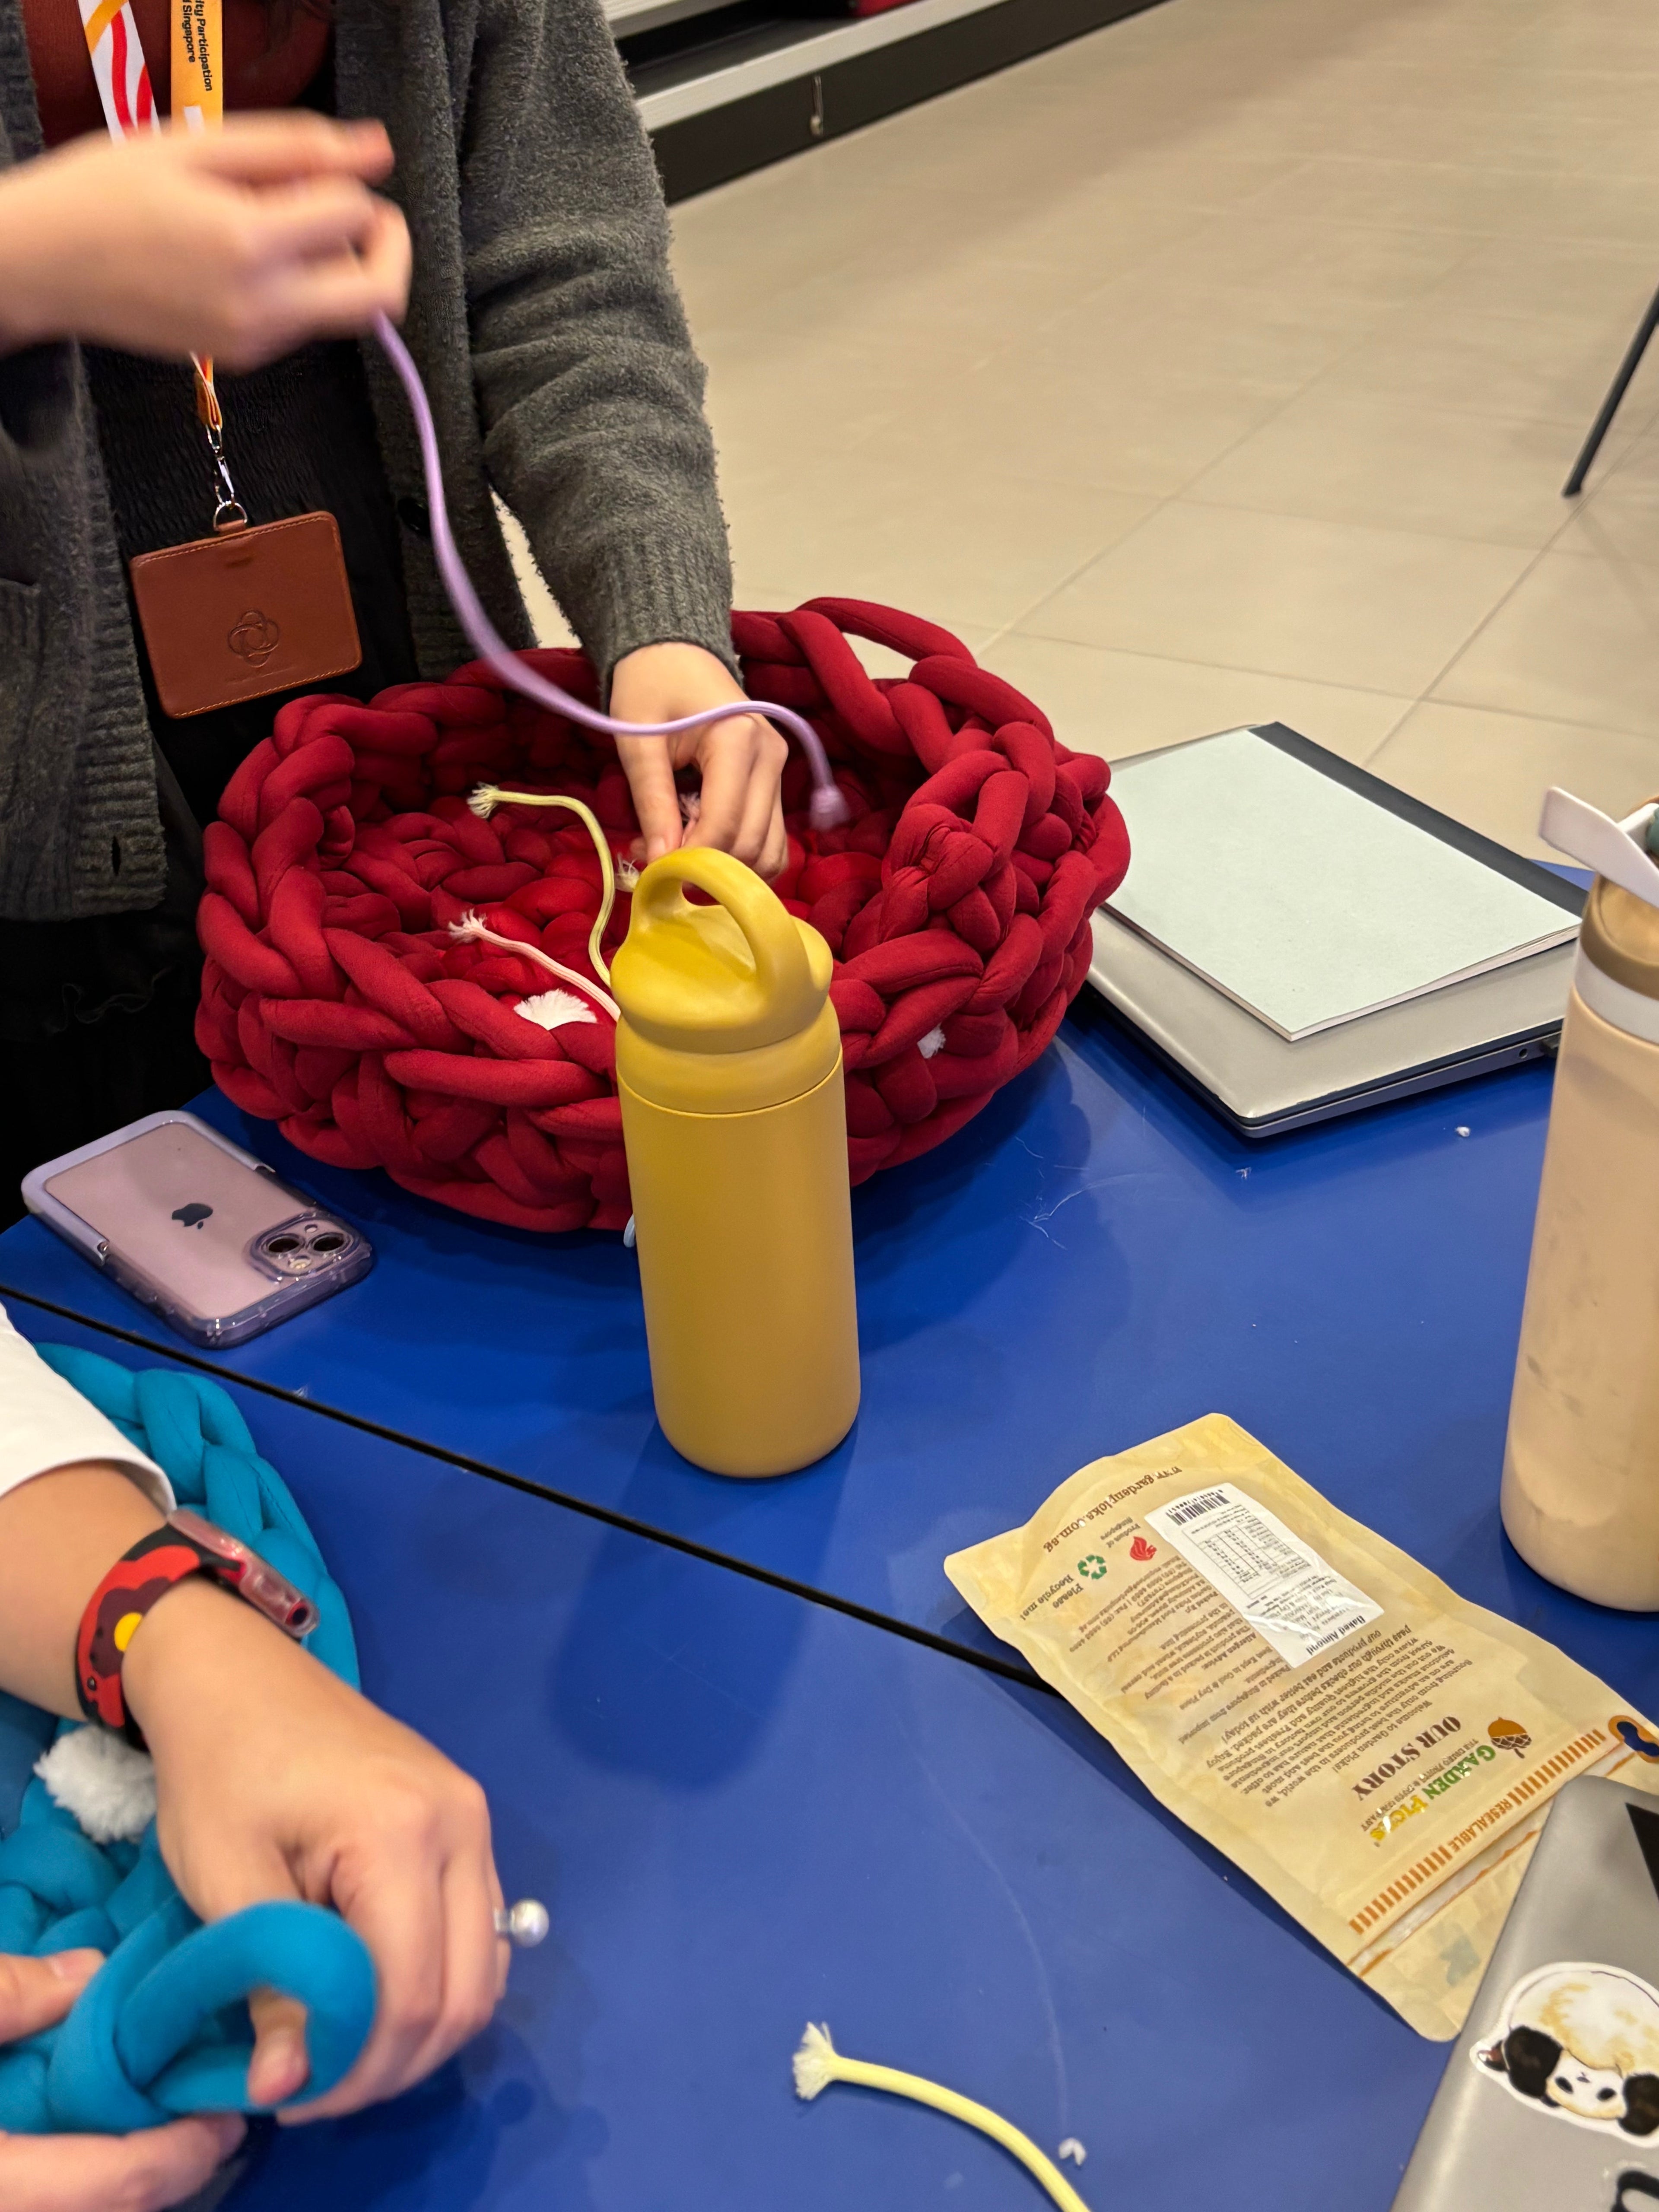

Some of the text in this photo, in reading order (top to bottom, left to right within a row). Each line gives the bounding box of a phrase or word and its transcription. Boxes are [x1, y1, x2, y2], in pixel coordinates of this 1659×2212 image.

[182, 5, 195, 63] Singapore
[197, 18, 212, 91] Participation
[1043, 1466, 1182, 1552] wwwgardenpicks.com.sg
[1020, 1574, 1074, 1621] Recycle me!
[1052, 1583, 1084, 1608] Please
[1338, 1615, 1365, 1635] Baked
[1306, 1631, 1338, 1655] Almond
[1367, 1630, 1381, 1643] our
[1201, 1632, 1256, 1670] Allergen Advice:
[1332, 1637, 1368, 1665] products
[1376, 1653, 1395, 1666] only
[1389, 1654, 1410, 1667] from
[1417, 1652, 1432, 1661] cut
[1265, 1664, 1291, 1684] Packed
[1316, 1662, 1333, 1678] and
[1362, 1665, 1379, 1675] the
[1376, 1668, 1391, 1678] the
[1390, 1669, 1407, 1678] the
[1404, 1660, 1419, 1669] out
[1435, 1659, 1473, 1683] Sourcing
[1440, 1660, 1455, 1669] are
[1302, 1673, 1317, 1686] eat
[1334, 1674, 1366, 1695] highest
[1344, 1677, 1377, 1699] growers
[1363, 1678, 1392, 1697] middle
[1393, 1670, 1421, 1688] snacks
[1417, 1681, 1439, 1696] from
[1206, 1624, 1411, 1768] pass through our checks before they are packed. Enjoy
[1226, 1685, 1260, 1710] Singapore
[1279, 1682, 1306, 1702] better
[1377, 1687, 1395, 1699] and
[1379, 1681, 1420, 1711] adventure
[1259, 1699, 1280, 1715] with
[1306, 1694, 1337, 1716] Quality
[1322, 1705, 1337, 1716] our
[1337, 1695, 1365, 1716] person
[1400, 1695, 1419, 1709] only
[1209, 1708, 1227, 1722] from
[1289, 1713, 1307, 1727] and
[1333, 1698, 1380, 1731] ingredients
[1386, 1708, 1402, 1718] the
[1395, 1700, 1433, 1724] Welcome
[1303, 1716, 1322, 1728] own
[1321, 1716, 1338, 1728] and
[1347, 1717, 1373, 1733] bring
[1368, 1717, 1389, 1730] best
[1221, 1720, 1250, 1745] today!
[1254, 1725, 1292, 1749] Freshest
[1274, 1728, 1306, 1749] factory
[1293, 1726, 1323, 1746] import
[1316, 1730, 1336, 1743] that
[1332, 1731, 1349, 1743] you
[1357, 1730, 1389, 1752] Garden
[1279, 1746, 1294, 1758] our
[1288, 1742, 1317, 1761] nature
[1318, 1742, 1335, 1752] the
[1328, 1729, 1370, 1759] producers
[1223, 1754, 1267, 1781] Singapore
[1272, 1760, 1290, 1772] has
[1300, 1752, 1321, 1766] best
[1332, 1751, 1360, 1773] Picks!
[1352, 1716, 1461, 1801] OUR STORY
[1231, 1756, 1280, 1789] ingredients
[1284, 1764, 1301, 1778] and
[1304, 1765, 1322, 1776] the
[1421, 1745, 1495, 1799] GARDEN
[1241, 1778, 1264, 1794] offer.
[1262, 1776, 1285, 1793] most
[1277, 1776, 1306, 1796] world,
[1448, 1799, 1513, 1851] RESEALABLE
